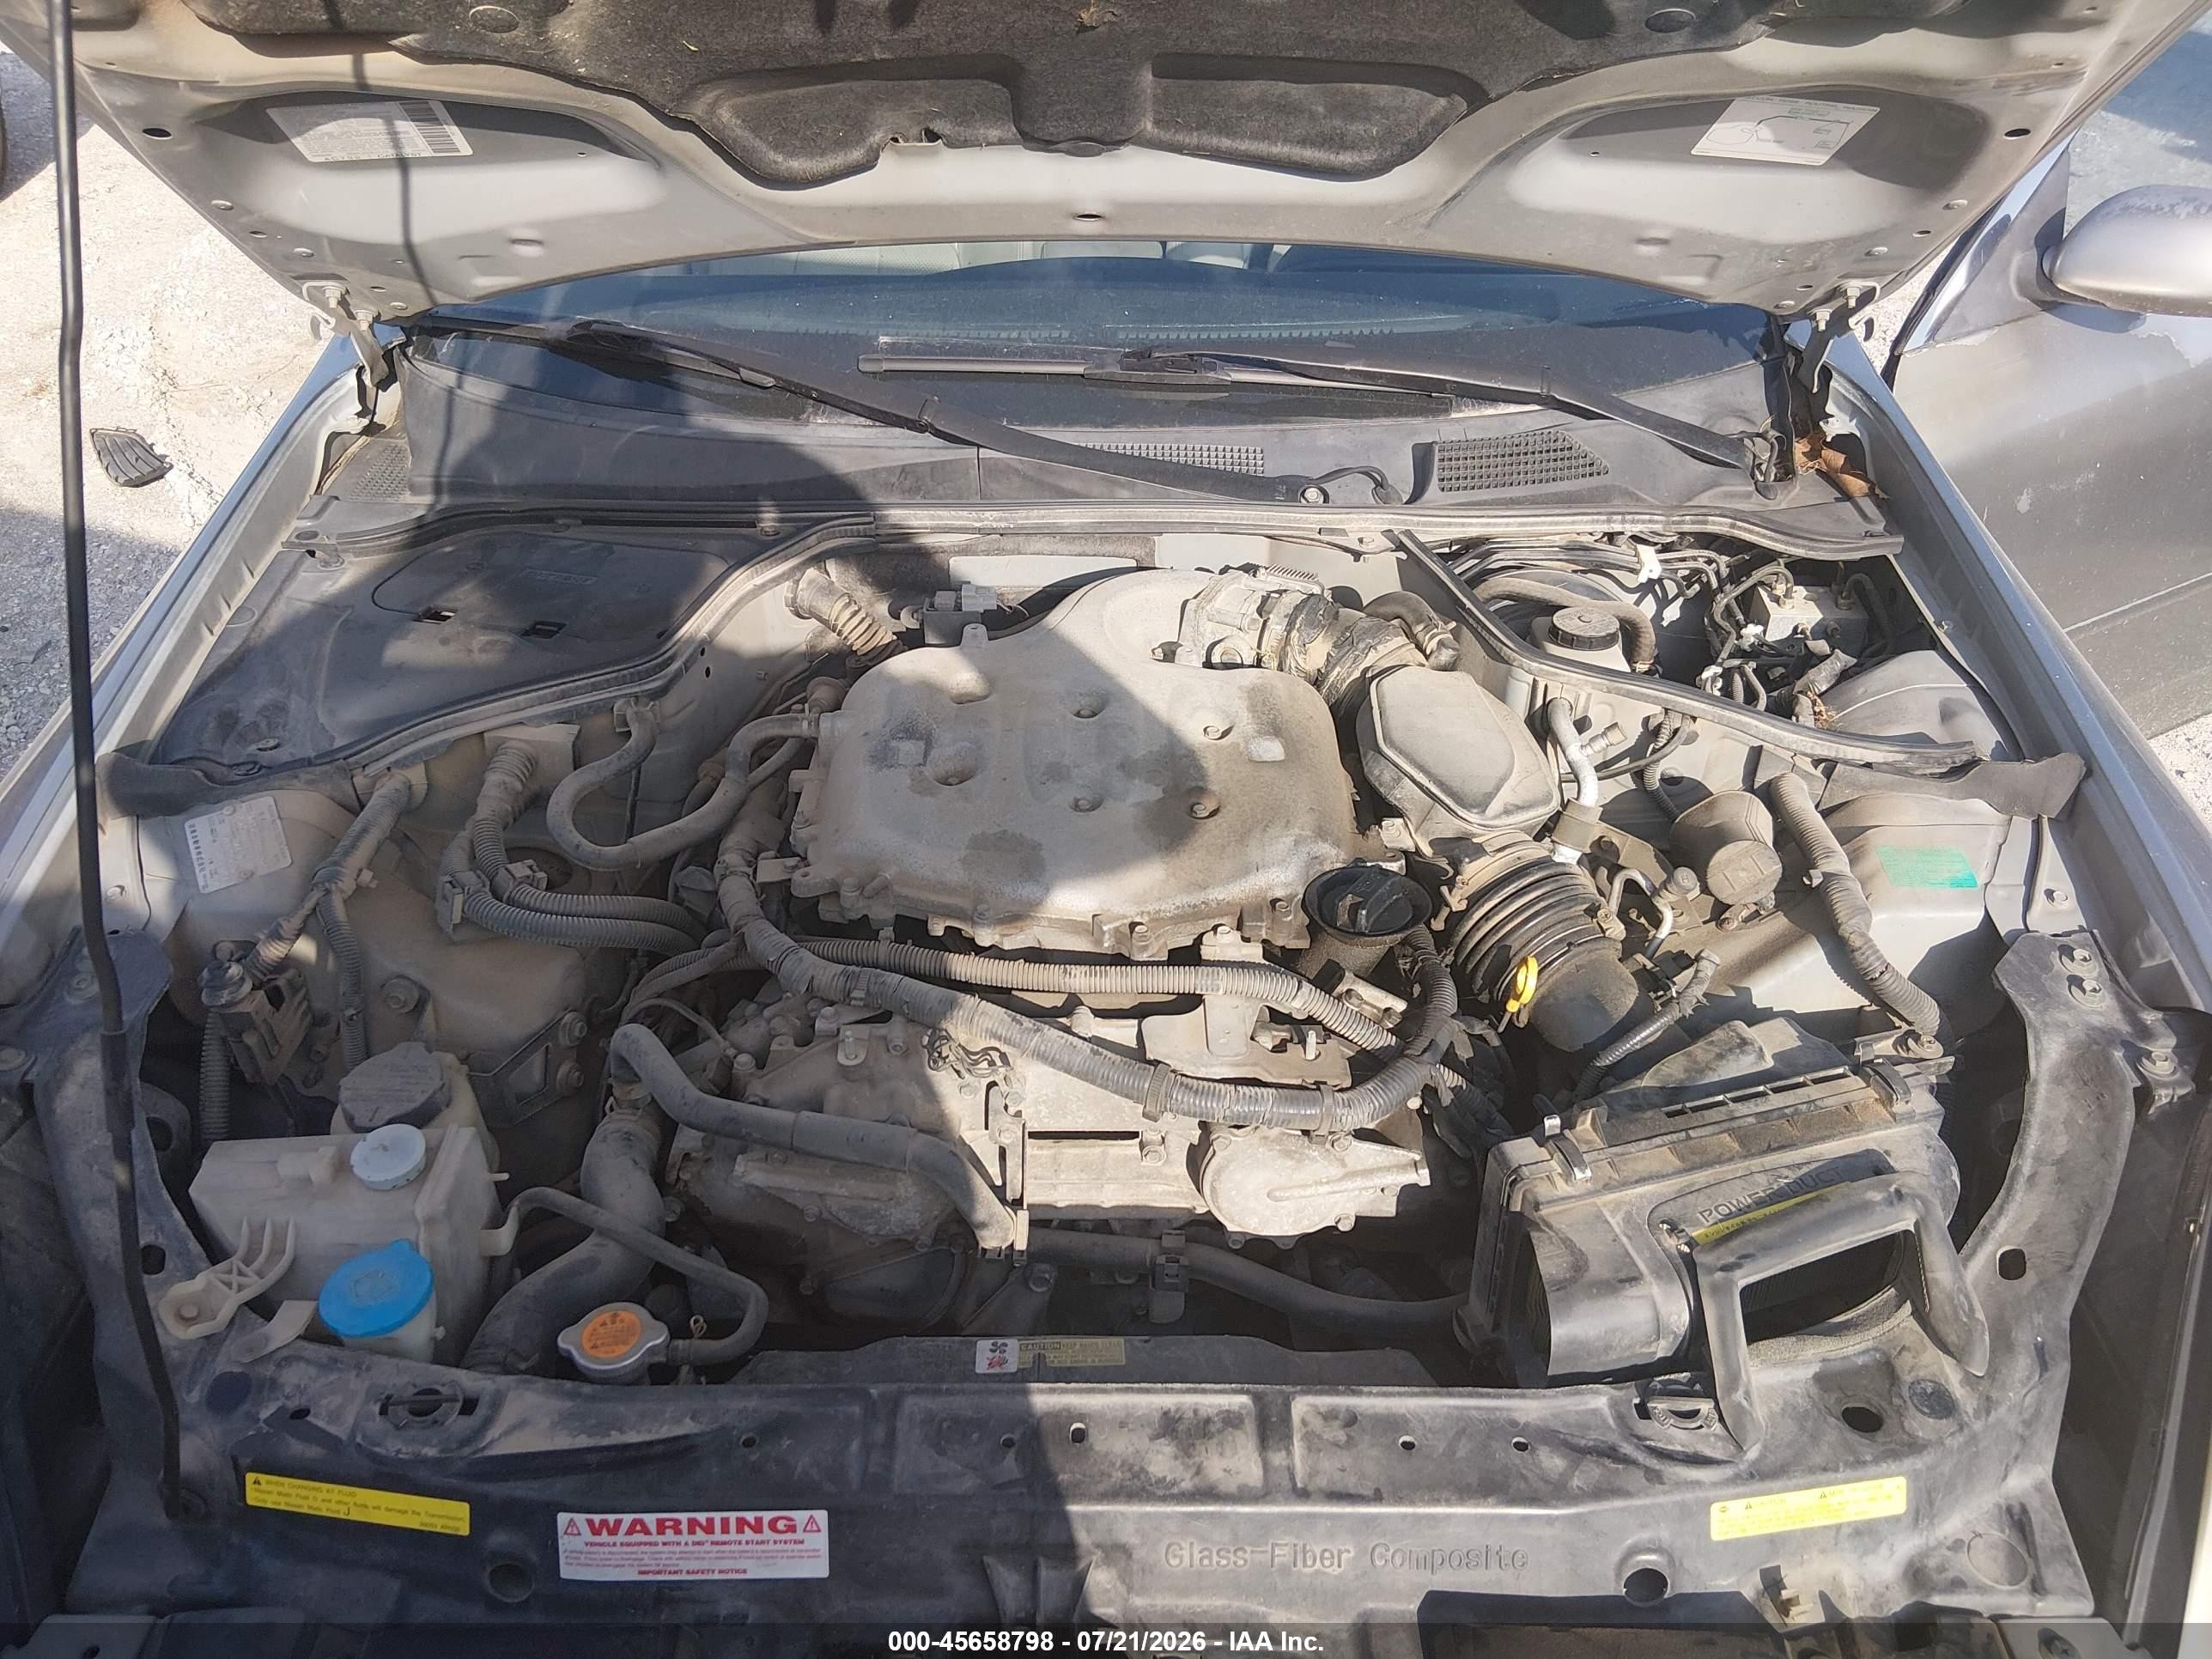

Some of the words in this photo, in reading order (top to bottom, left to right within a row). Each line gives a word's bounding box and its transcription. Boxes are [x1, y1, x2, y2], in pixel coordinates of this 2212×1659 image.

[1698, 1185, 1780, 1224] POWER
[1787, 1165, 1844, 1194] DUCT
[1020, 1341, 1060, 1351] CAUTION
[585, 1516, 798, 1537] WARNING
[1164, 1540, 1352, 1569] Glass-Fiber
[1370, 1542, 1528, 1575] Composite
